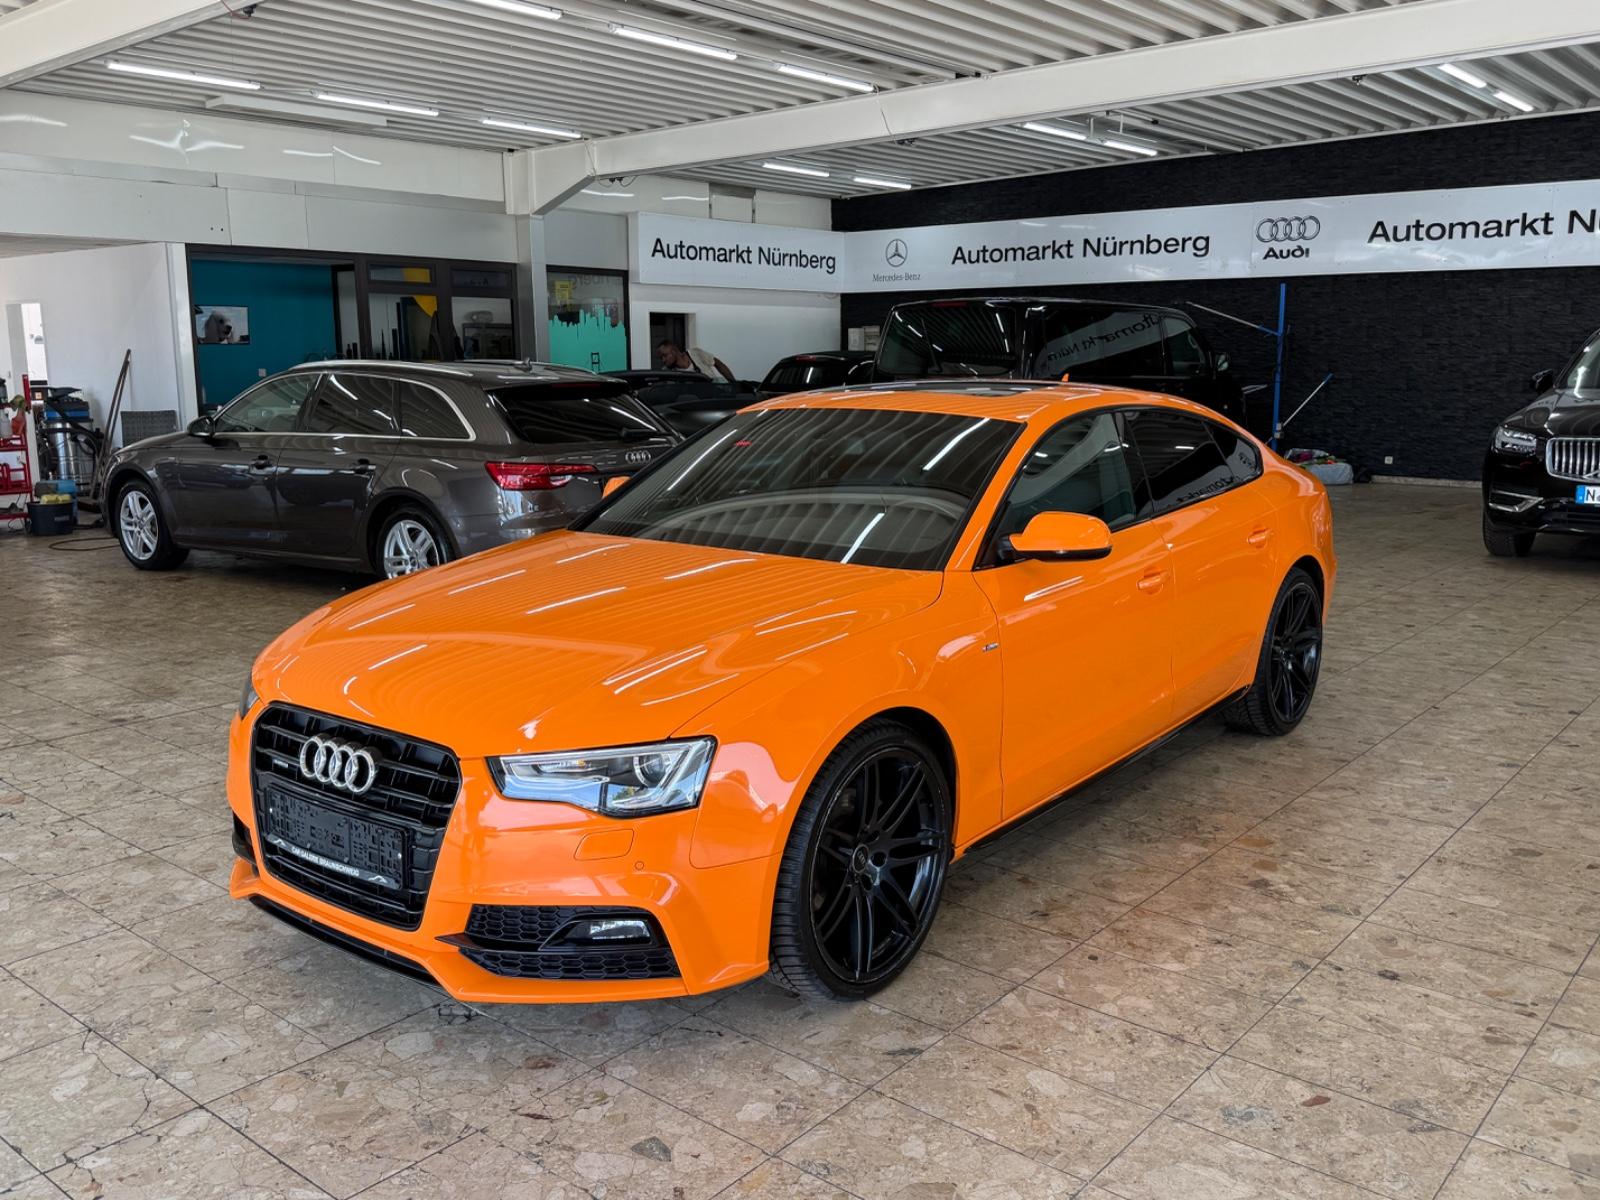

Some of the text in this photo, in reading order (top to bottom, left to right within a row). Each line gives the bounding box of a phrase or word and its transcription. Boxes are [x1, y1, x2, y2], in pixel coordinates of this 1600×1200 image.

[1367, 208, 1600, 244] Automarkt N
[651, 237, 836, 275] Automarkt Nürnberg
[951, 233, 1210, 265] Automarkt Nürnberg
[1262, 244, 1310, 260] Audi
[872, 272, 921, 282] Mercedes-Benz
